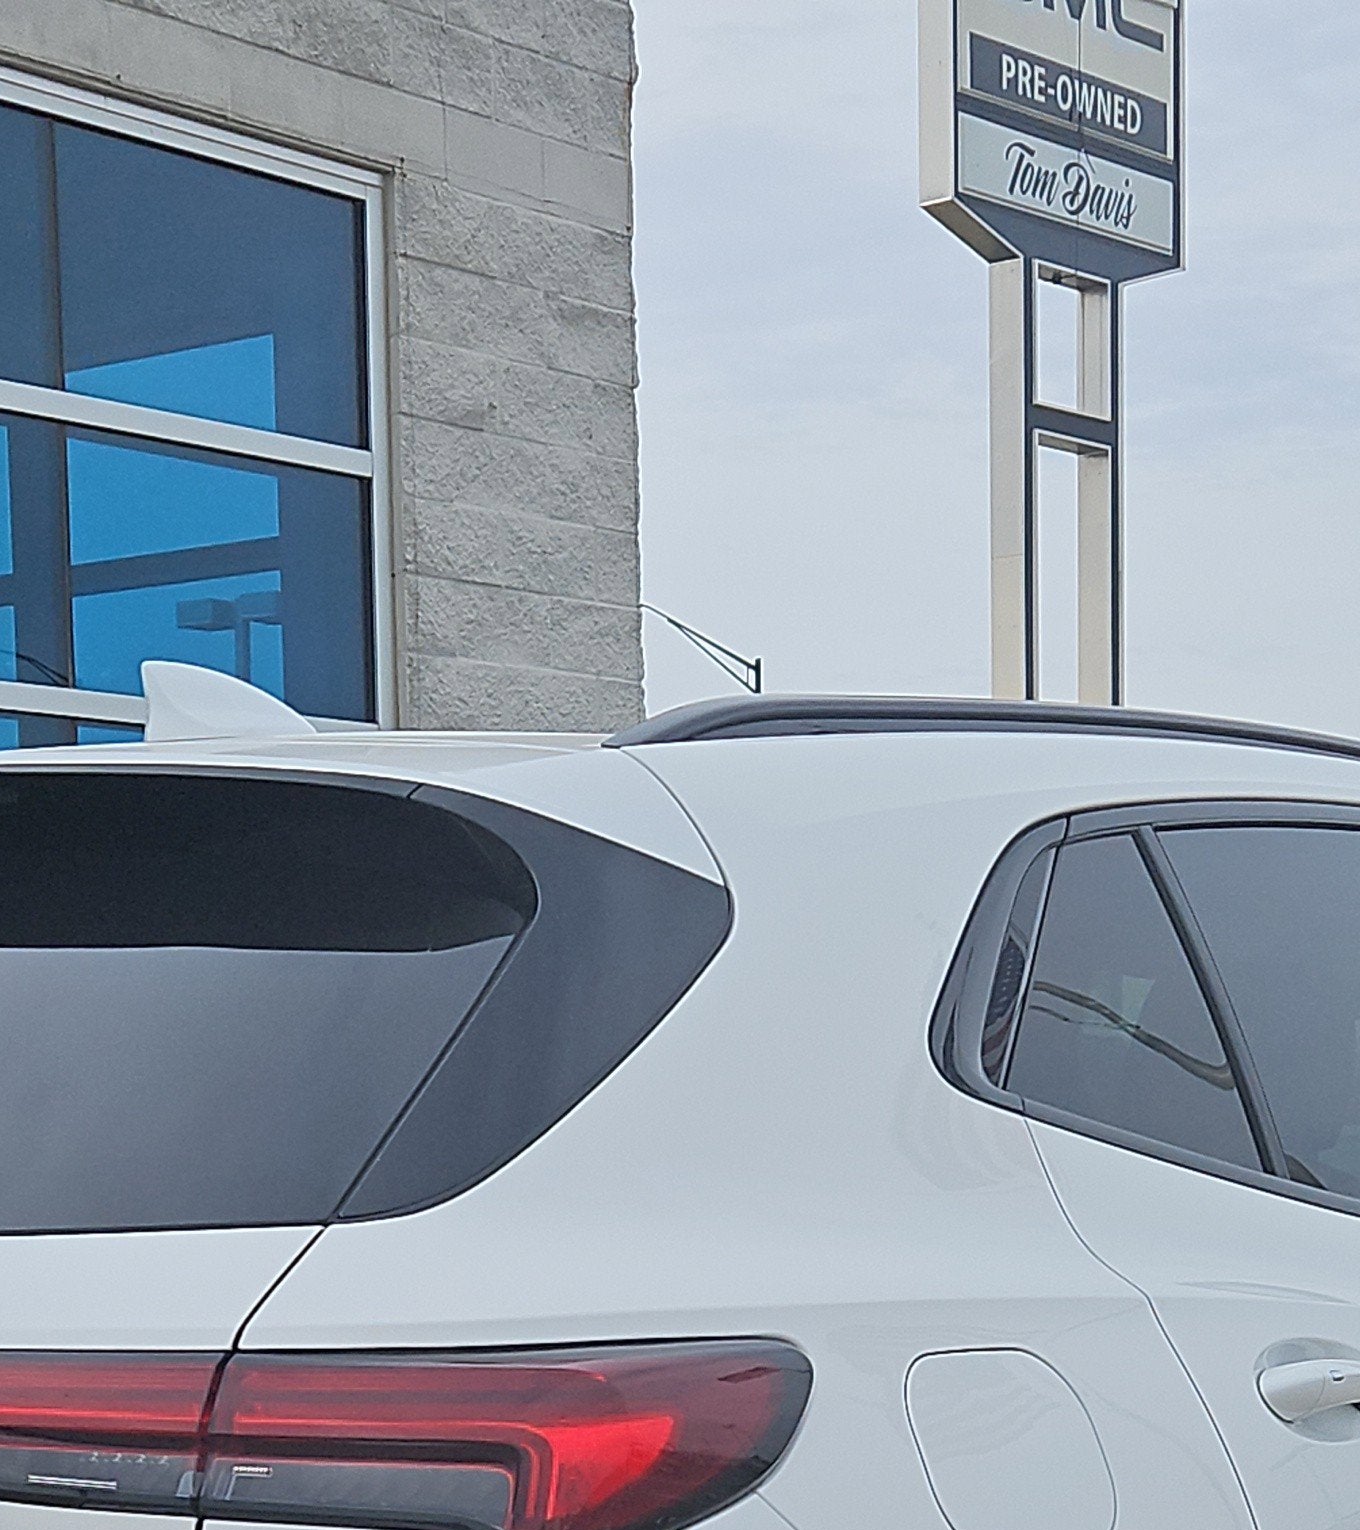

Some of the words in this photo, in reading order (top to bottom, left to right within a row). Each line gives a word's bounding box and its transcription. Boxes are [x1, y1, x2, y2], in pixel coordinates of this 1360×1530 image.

[1001, 53, 1142, 135] PRE-OWNED
[1005, 141, 1060, 207] Tom
[1061, 161, 1138, 230] Davis
